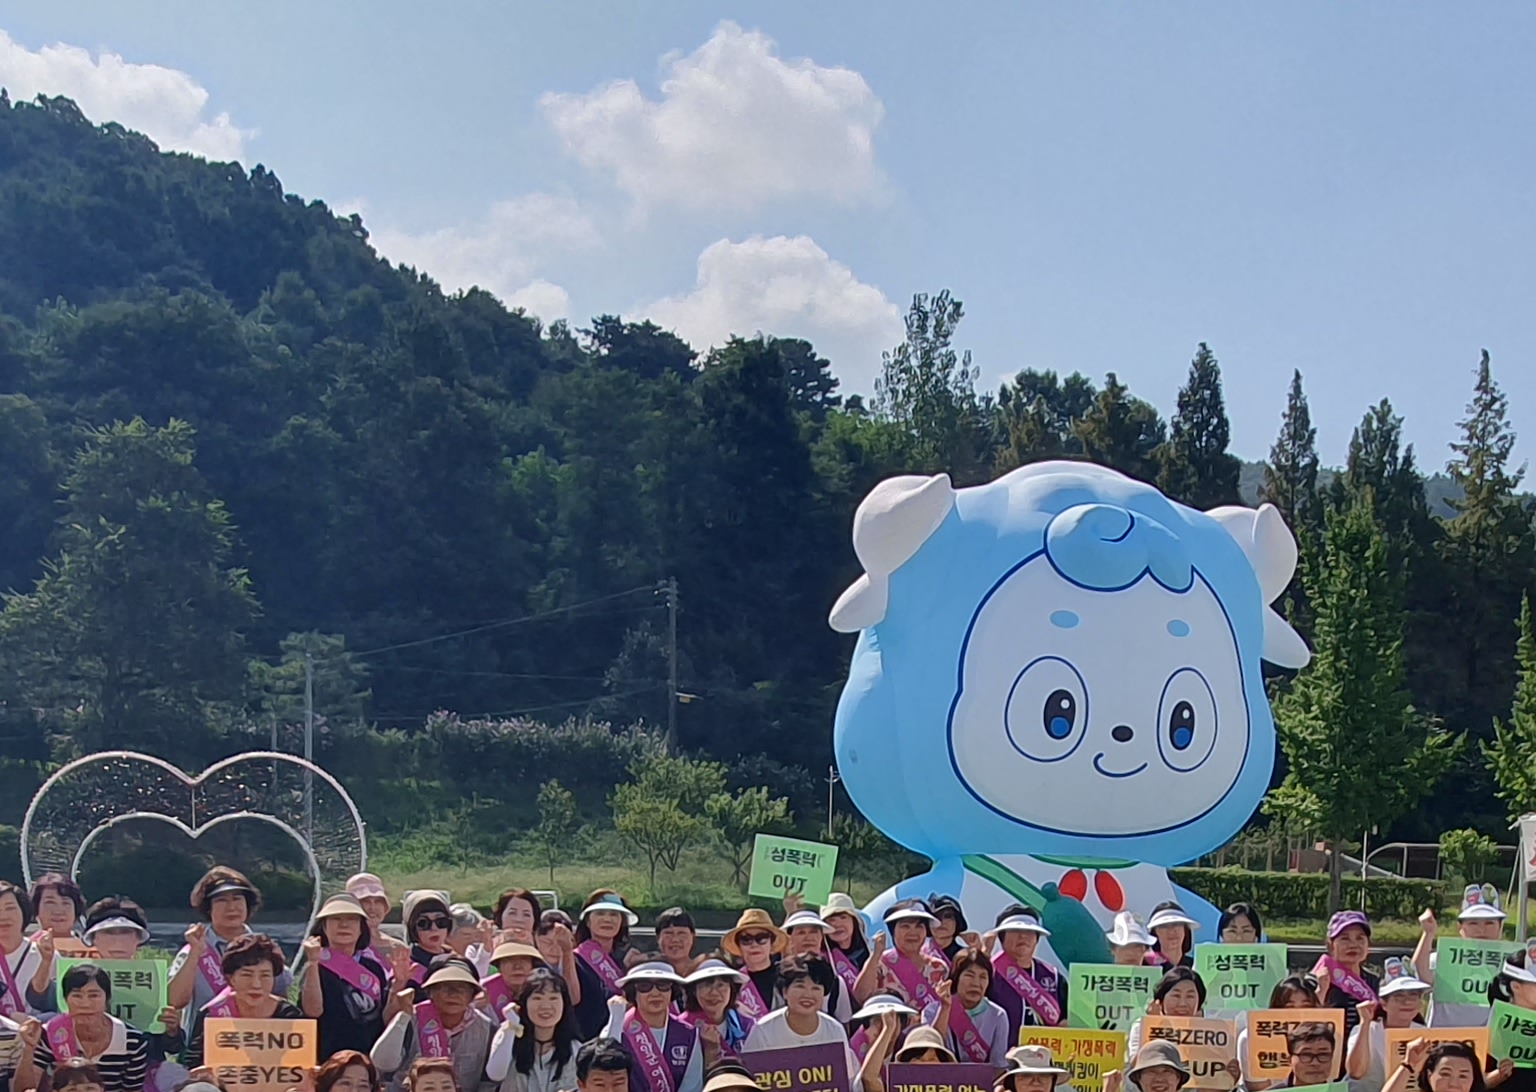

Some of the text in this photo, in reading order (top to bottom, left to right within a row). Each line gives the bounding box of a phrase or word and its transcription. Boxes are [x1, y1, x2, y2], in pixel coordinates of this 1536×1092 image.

[771, 846, 817, 868] 성폭력
[772, 874, 809, 896] OUT
[1215, 954, 1265, 971] 성폭력
[1449, 946, 1505, 968] 가정폭
[1081, 975, 1149, 993] 가정폭력
[1220, 983, 1260, 999] OUT
[1461, 978, 1489, 993] OU
[1095, 1004, 1135, 1021] OUT
[216, 1031, 304, 1051] 폭력NO
[1148, 1027, 1228, 1047] 폭력ZERO
[218, 1065, 304, 1085] 존중YES
[753, 1064, 832, 1091] 관심 ON!
